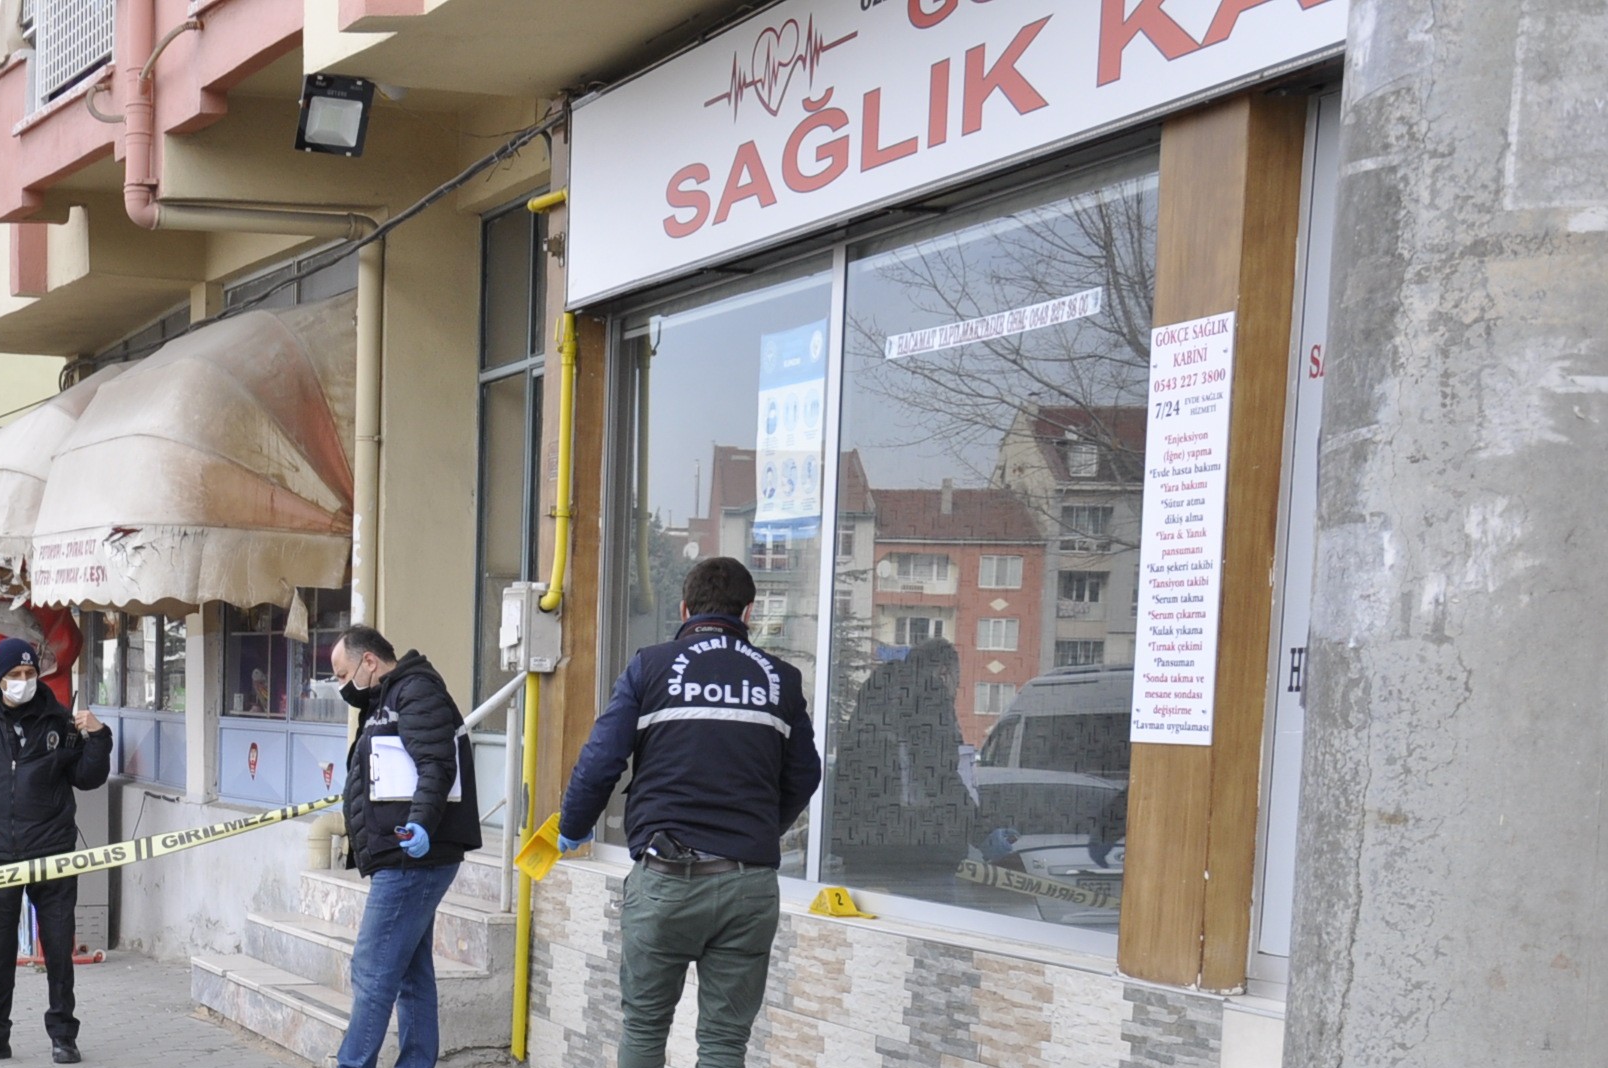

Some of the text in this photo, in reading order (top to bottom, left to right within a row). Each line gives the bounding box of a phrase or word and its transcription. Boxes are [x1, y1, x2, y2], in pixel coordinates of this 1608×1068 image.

[663, 14, 1052, 239] SAĞLIK
[1155, 319, 1229, 347] GÖKÇE SAĞLIK
[1173, 343, 1208, 368] KABİNİ
[1154, 368, 1226, 393] 0543 227 3800
[1184, 391, 1224, 405] EVDE SAĞLIK
[1155, 400, 1180, 420] 7/24
[1190, 404, 1217, 416] HİZMETİ
[1187, 448, 1212, 461] yapma
[1172, 467, 1192, 476] hasta
[1194, 462, 1221, 473] bakımı
[1181, 480, 1207, 491] bakımı
[1186, 497, 1205, 506] atma
[1164, 512, 1203, 525] dikiş alma
[1177, 530, 1183, 540] &
[1186, 527, 1207, 537] Yanık
[1161, 546, 1203, 560] pansumanı
[1166, 561, 1189, 574] şekeri
[1191, 559, 1213, 570] takibi
[1187, 576, 1209, 586] takibi
[1180, 593, 1204, 603] takma
[1176, 609, 1206, 622] çıkarma
[1175, 625, 1203, 638] yıkama
[1177, 641, 1203, 653] çekimi
[668, 653, 690, 696] OLAY
[1170, 673, 1193, 683] takma
[684, 680, 767, 706] POLİS
[1144, 689, 1203, 699] mesane sondası
[1152, 704, 1192, 718] değiştirme
[1167, 721, 1209, 734] uygulaması
[55, 846, 127, 873] POLİS
[835, 893, 844, 906] 2
